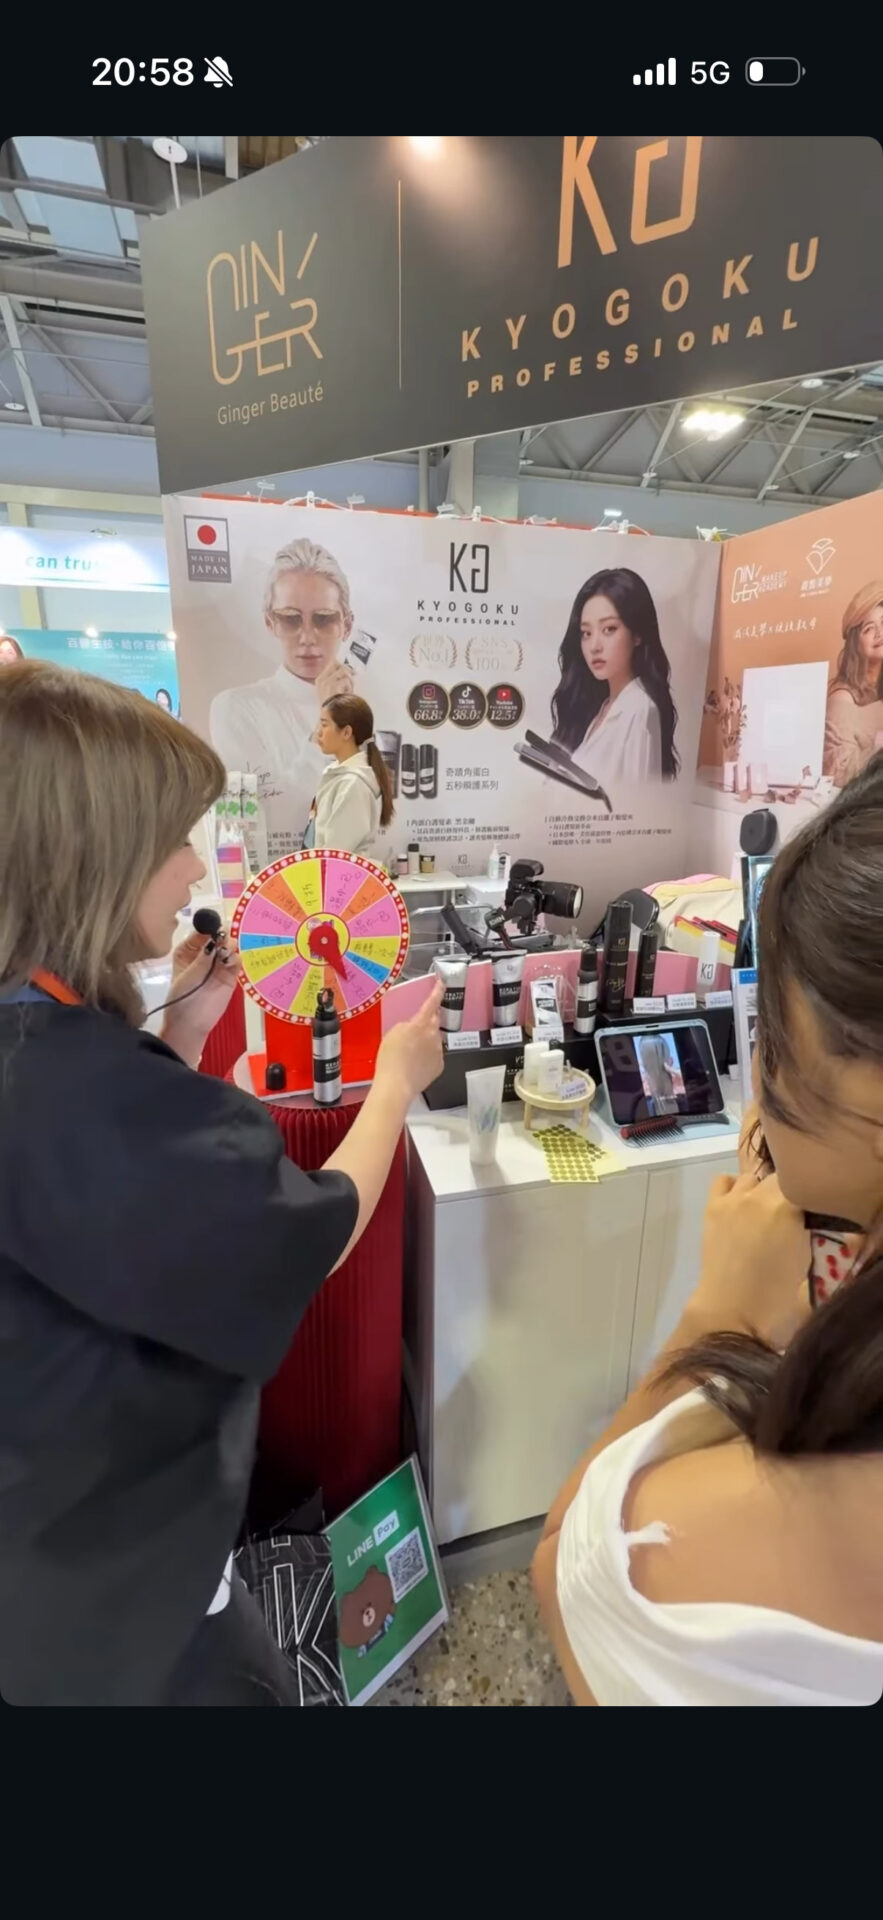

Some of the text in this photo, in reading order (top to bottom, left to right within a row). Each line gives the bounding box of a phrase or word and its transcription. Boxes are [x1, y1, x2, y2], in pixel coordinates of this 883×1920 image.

[461, 237, 819, 362] KYOGOKU
[467, 308, 797, 398] PROFESSIONAL
[217, 380, 324, 425] Ginger Beauté
[191, 564, 228, 576] JAPAN
[417, 600, 519, 615] KYOGOKU
[419, 615, 516, 626] PROFESSIONAL
[413, 709, 438, 721] 66.8
[452, 709, 477, 721] 38.0
[490, 710, 512, 721] 12.5
[445, 767, 490, 777] 奇蹟角蛋白
[347, 1518, 396, 1568] LINE Pay
